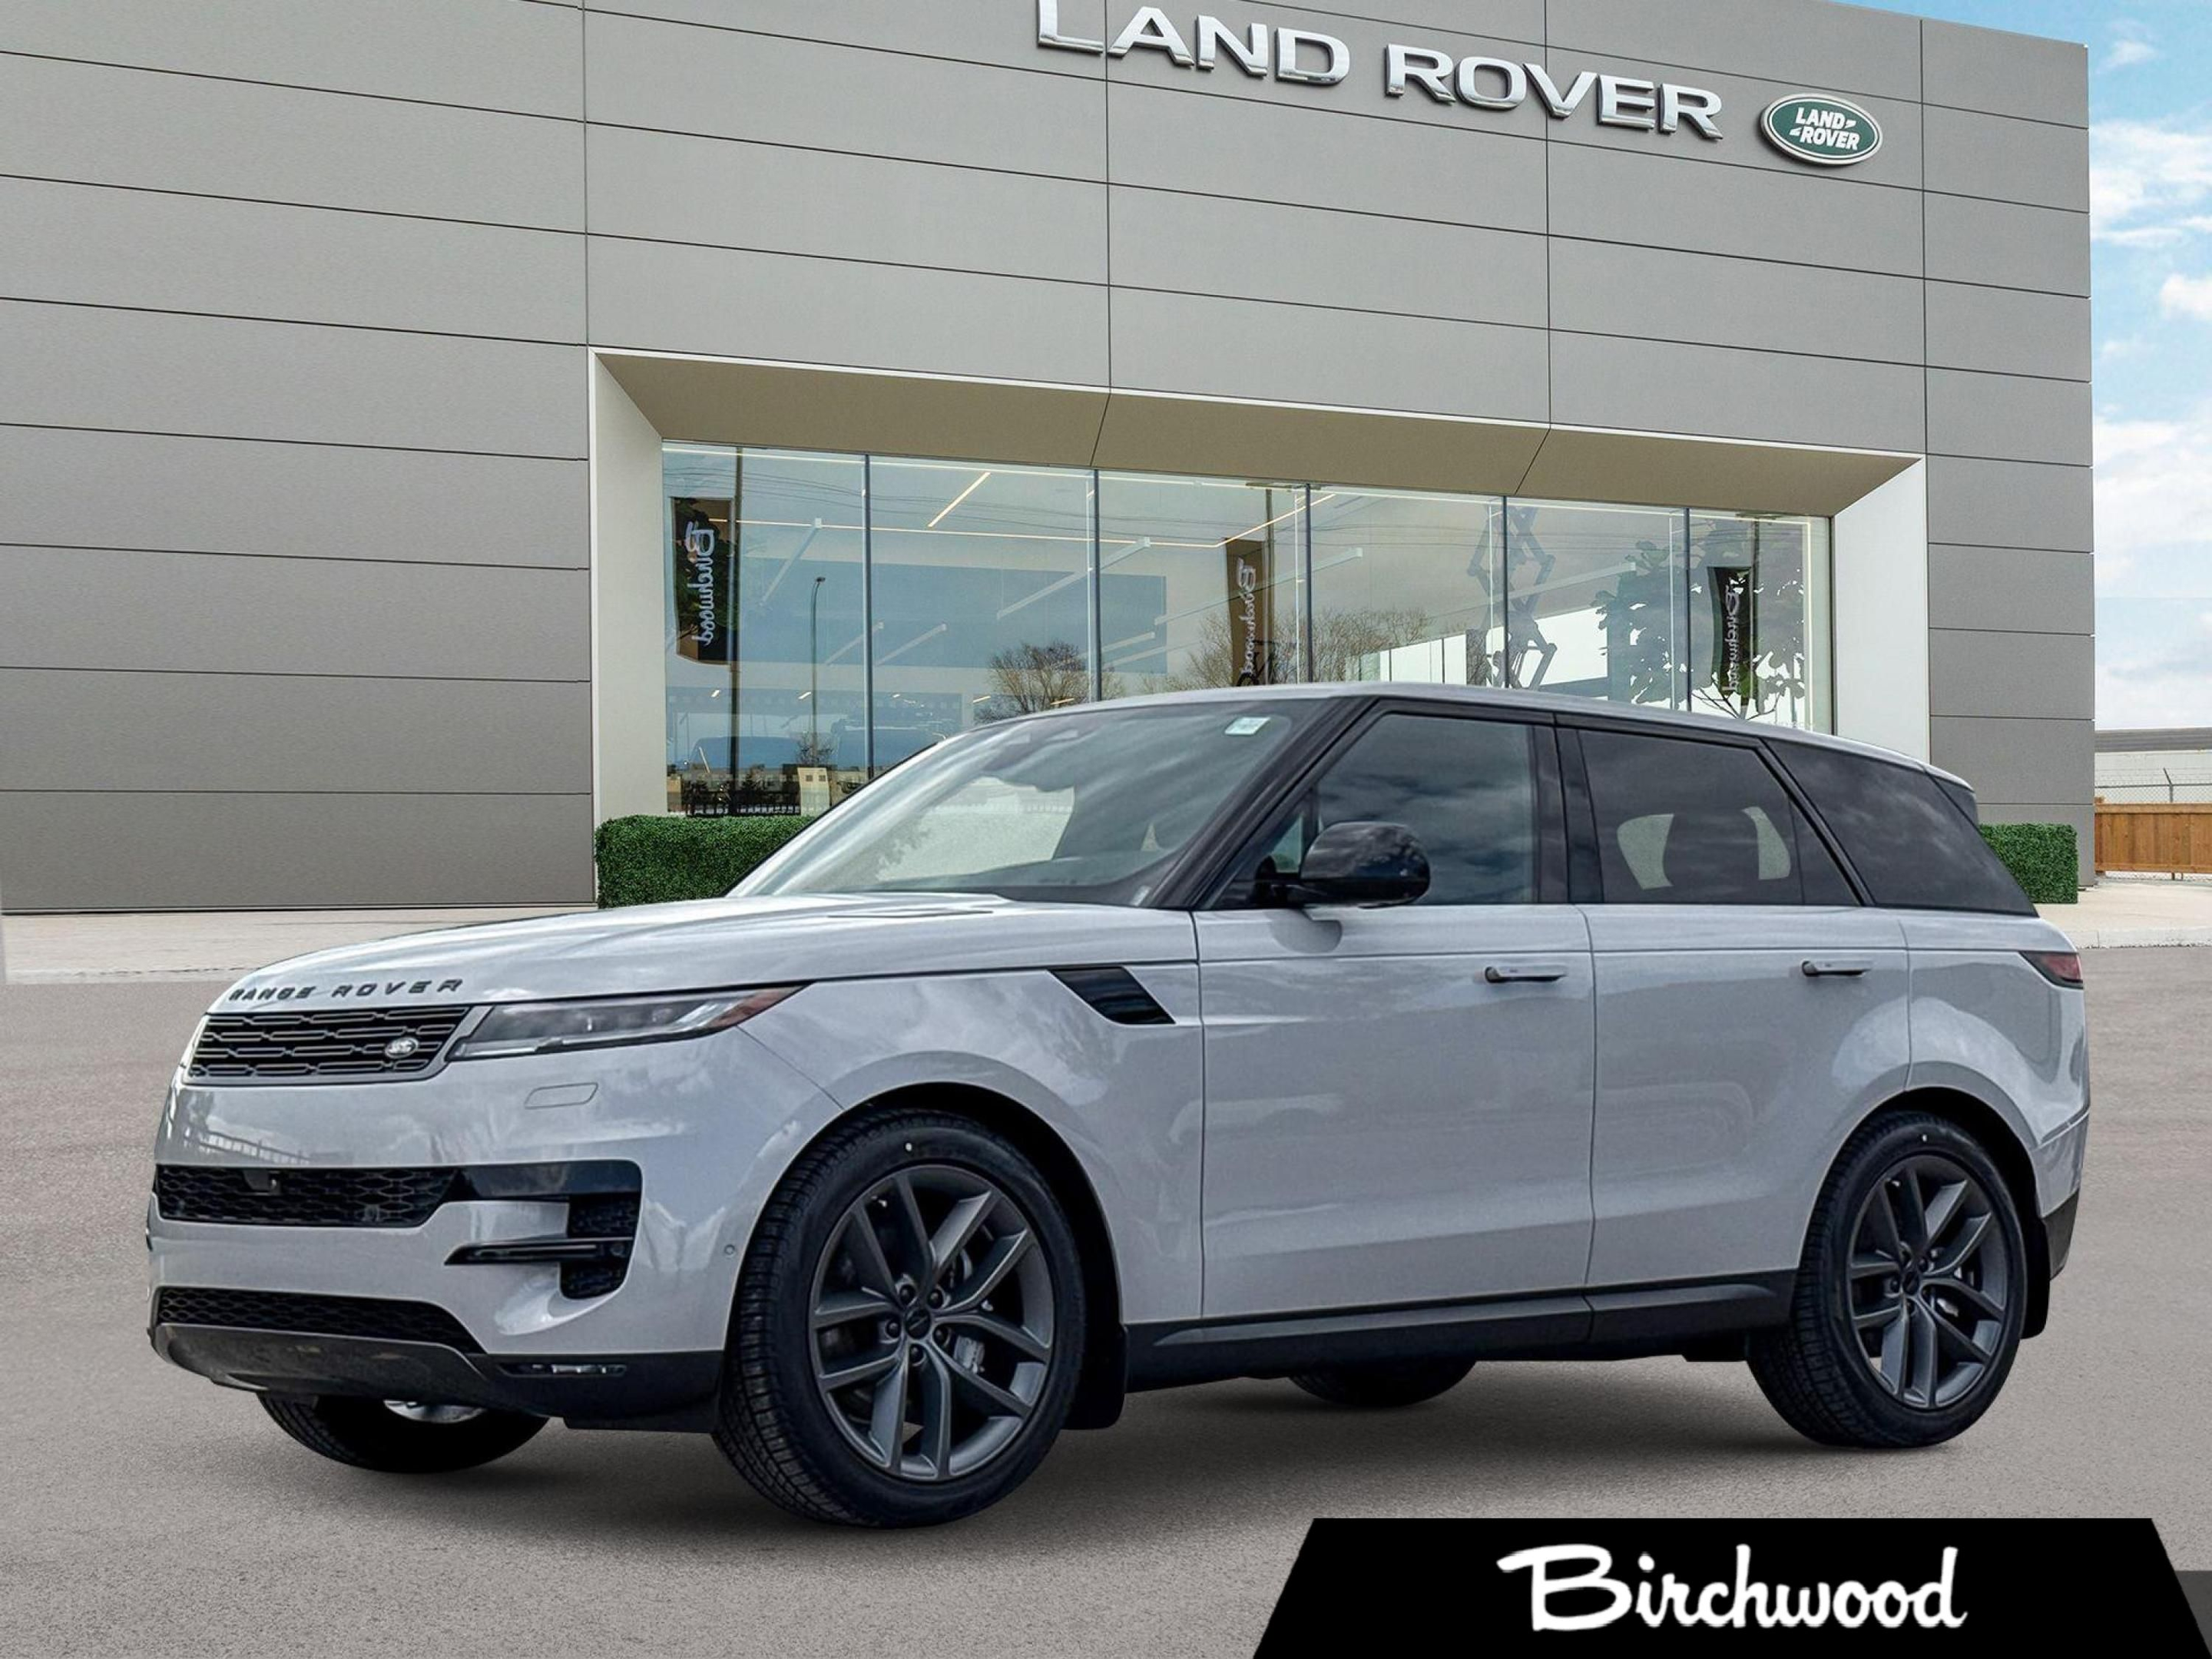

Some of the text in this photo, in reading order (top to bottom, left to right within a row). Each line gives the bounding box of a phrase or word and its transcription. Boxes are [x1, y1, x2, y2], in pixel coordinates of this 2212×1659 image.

[1038, 0, 1723, 140] LAND ROVER
[1799, 125, 1860, 150] ROVER
[228, 979, 463, 1000] RANGE ROVER
